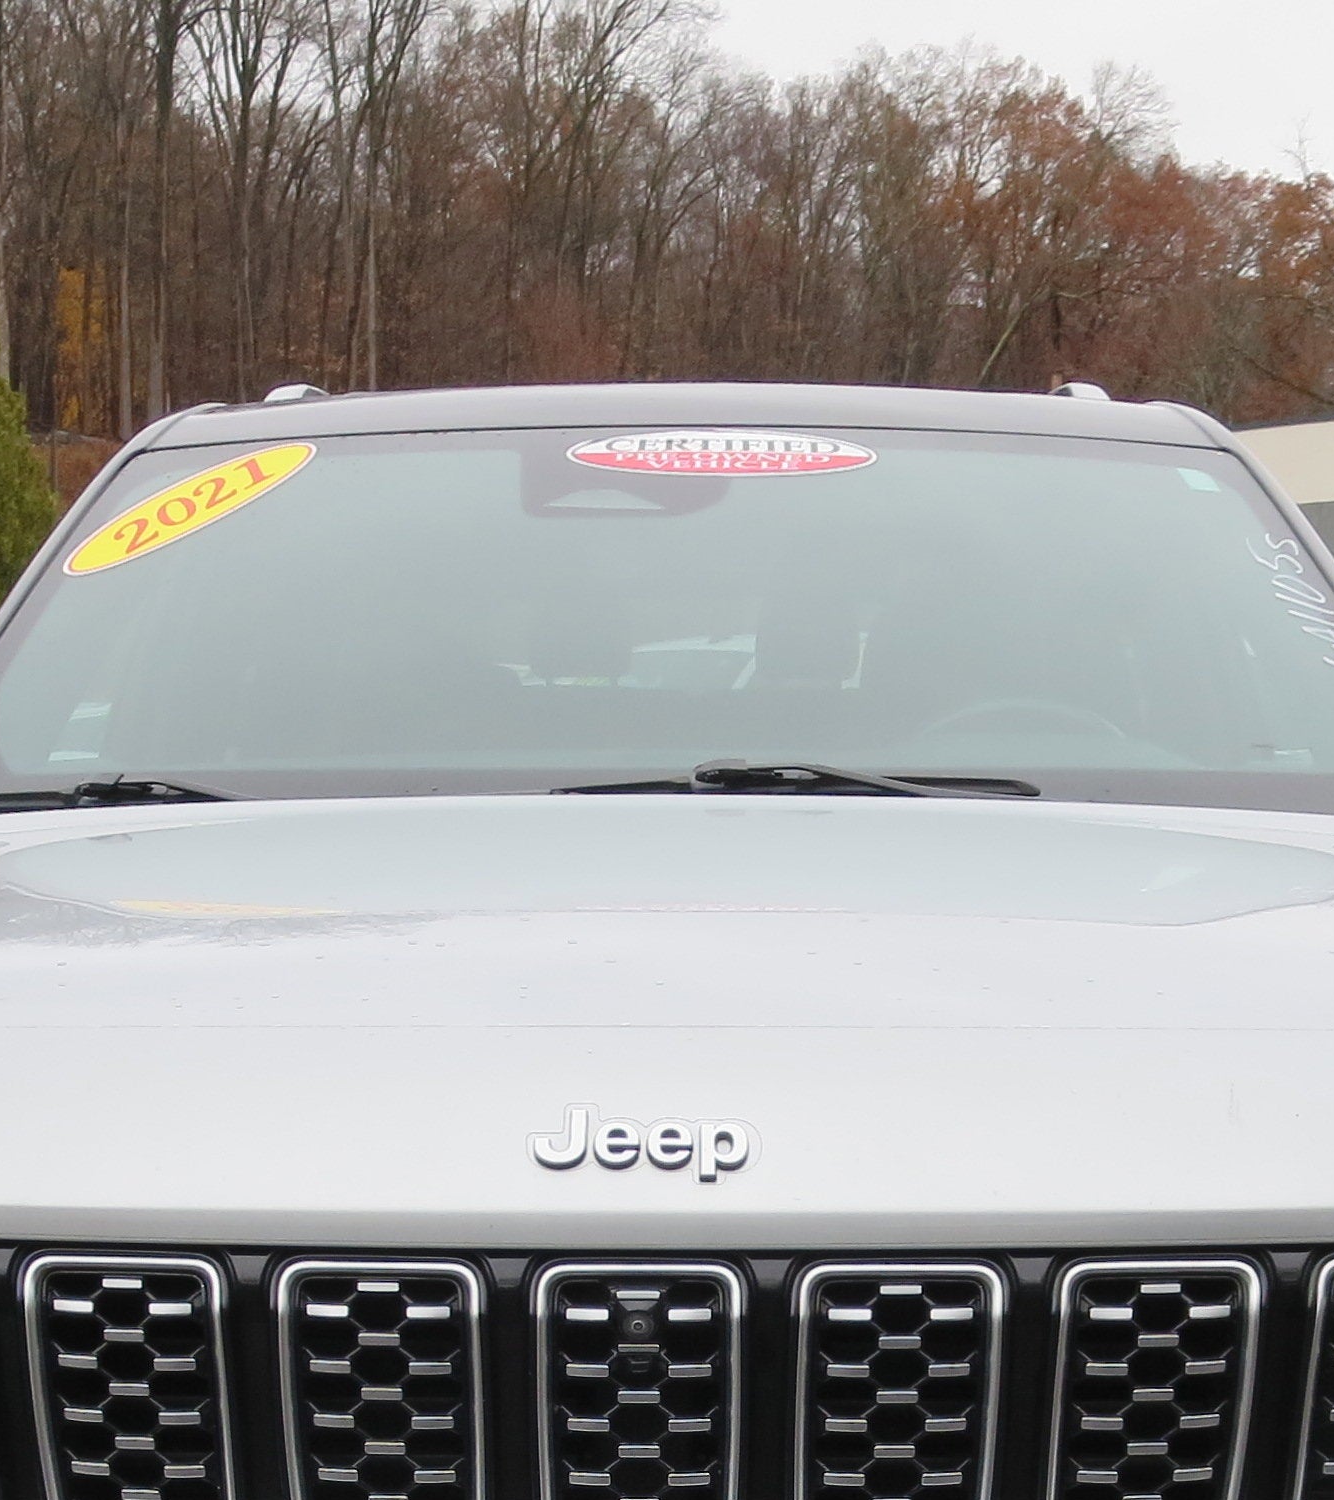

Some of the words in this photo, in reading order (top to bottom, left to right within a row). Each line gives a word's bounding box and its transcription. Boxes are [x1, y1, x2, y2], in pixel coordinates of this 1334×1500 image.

[605, 438, 841, 454] CERTIFIED
[646, 460, 800, 470] VEHICLE
[113, 458, 275, 554] 2021
[533, 1108, 749, 1183] Jeep
